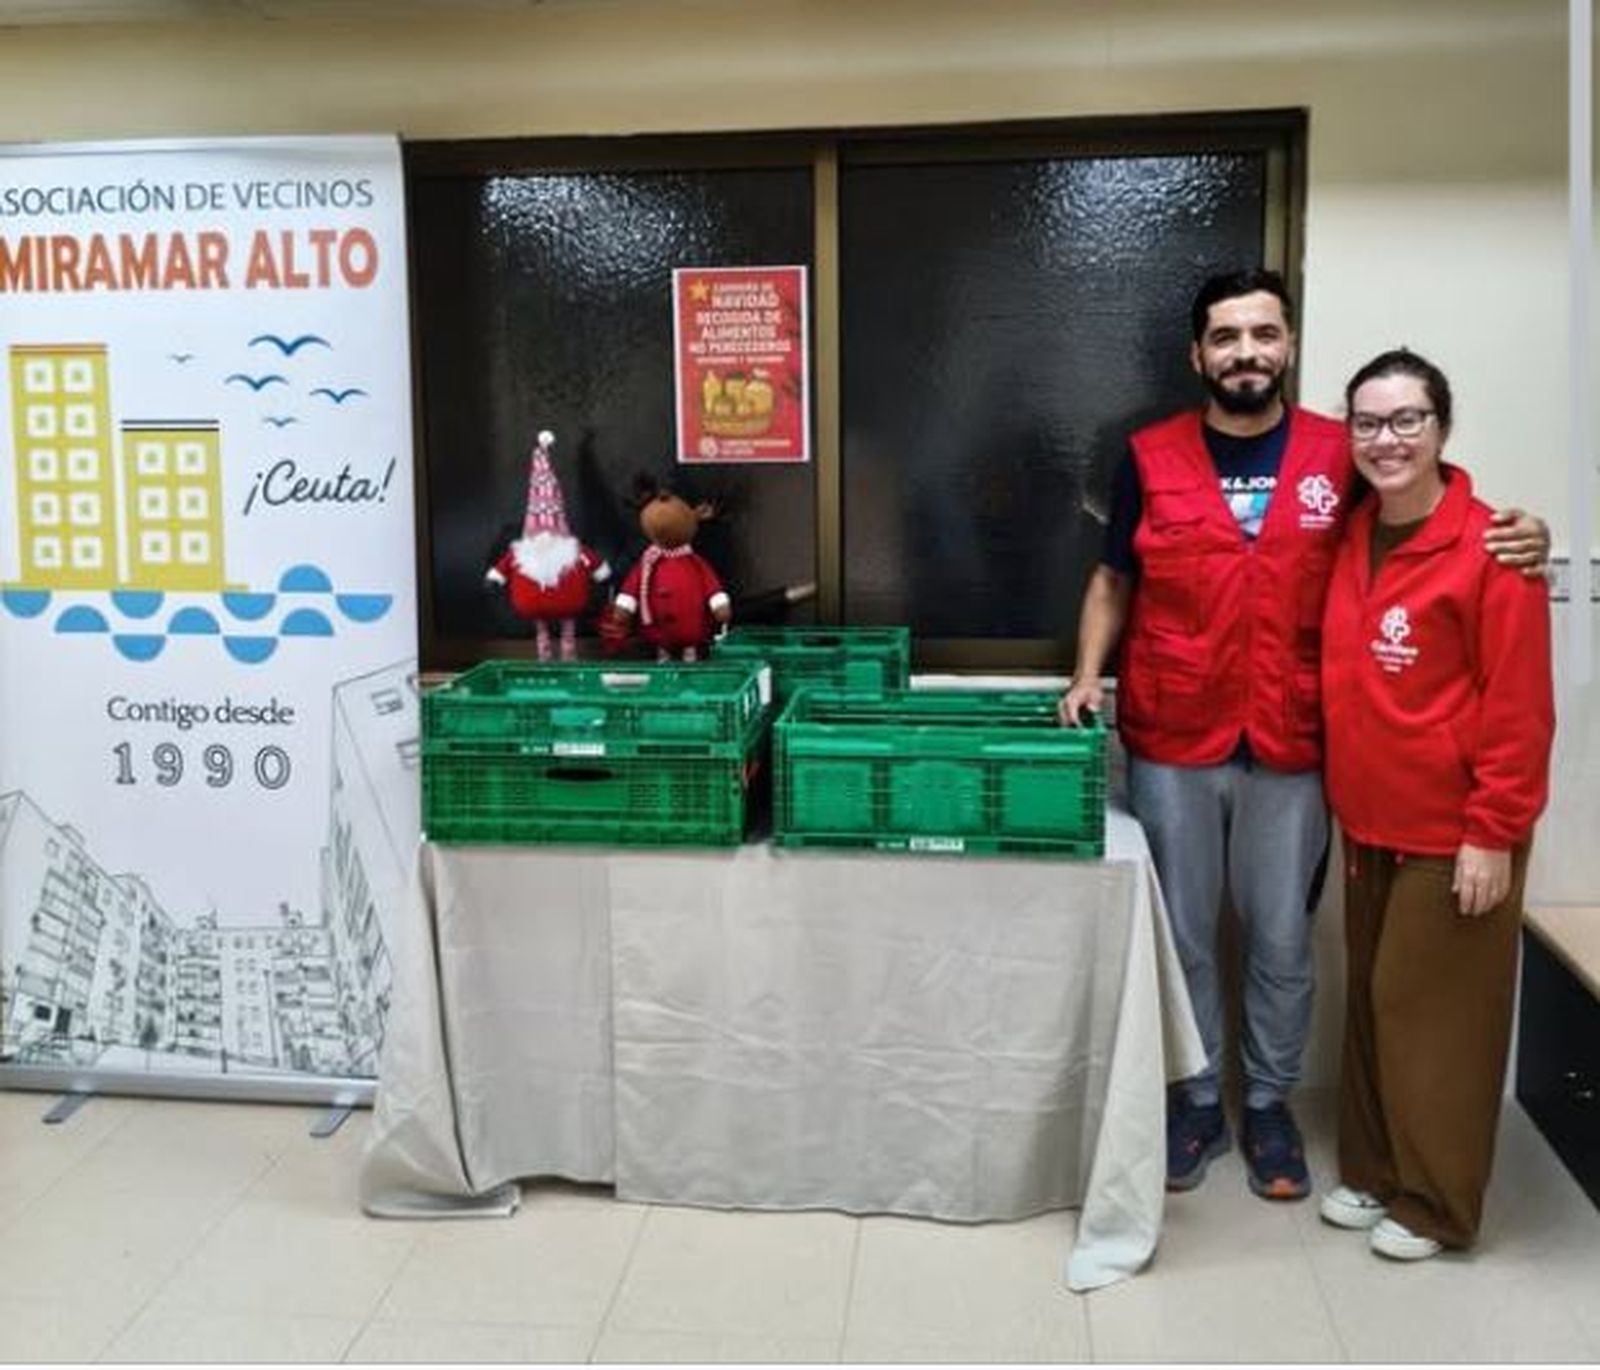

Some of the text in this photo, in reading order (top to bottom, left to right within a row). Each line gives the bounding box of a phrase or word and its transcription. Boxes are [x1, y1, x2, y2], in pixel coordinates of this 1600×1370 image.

[185, 183, 223, 211] DE
[233, 180, 373, 209] VECINOS
[0, 227, 379, 293] MIRAMAR ALTO
[711, 294, 780, 308] NAVIDAD
[701, 325, 776, 339] ALIMENTOS
[243, 458, 396, 516] ¡Ceuta!
[107, 695, 295, 729] Contigo desde
